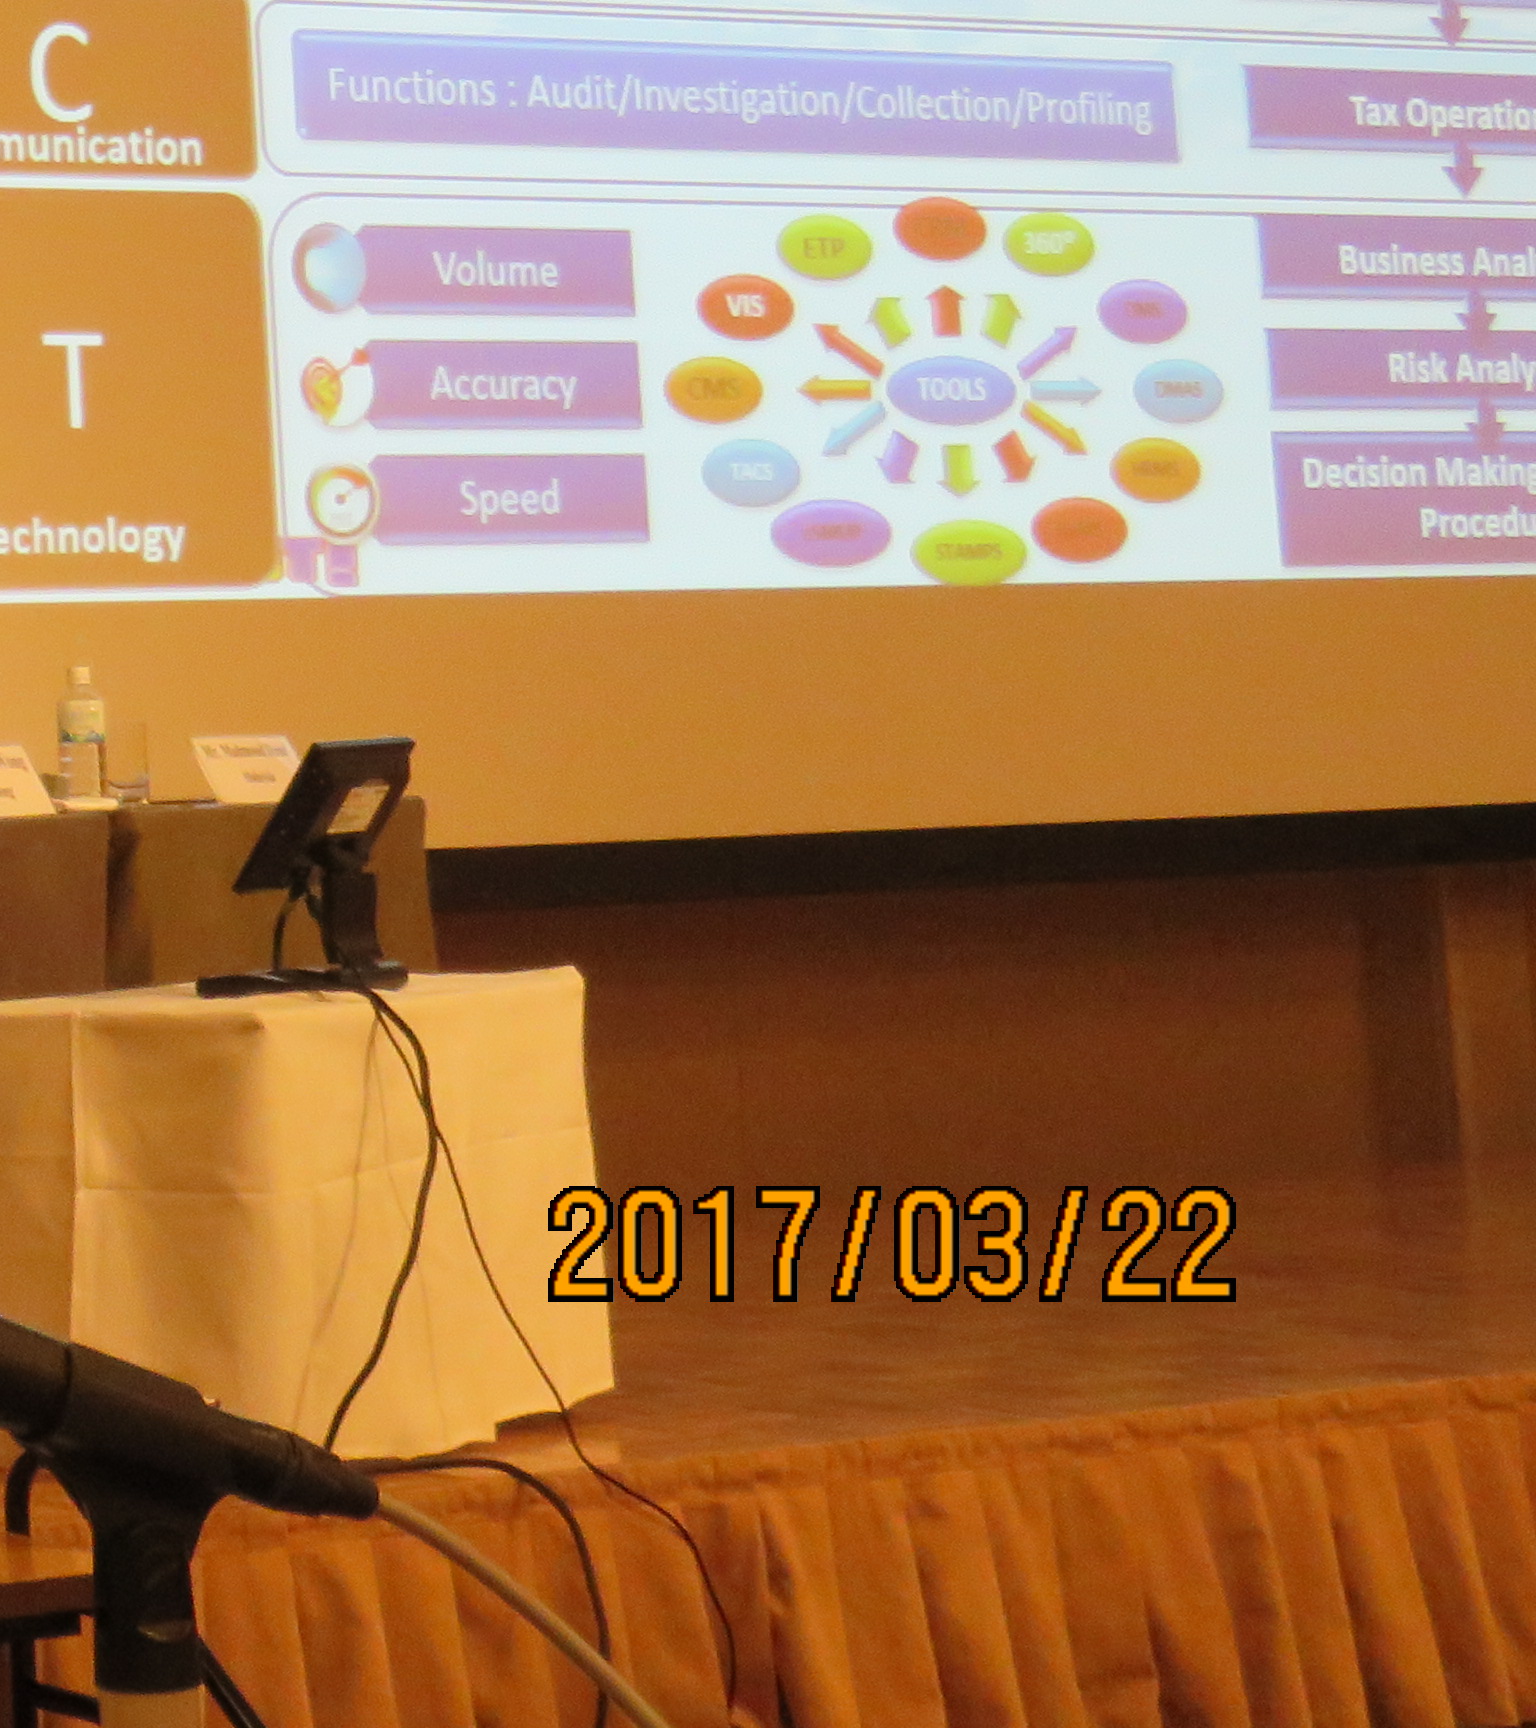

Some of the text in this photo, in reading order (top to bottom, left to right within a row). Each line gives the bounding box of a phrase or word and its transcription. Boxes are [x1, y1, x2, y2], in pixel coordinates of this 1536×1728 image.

[30, 21, 94, 123] C
[327, 68, 497, 109] Functions
[1348, 95, 1536, 138] Tax Operatio
[802, 236, 847, 259] ETP
[1337, 243, 1465, 276] Business
[431, 249, 560, 289] Volume
[724, 294, 766, 318] VIS
[41, 331, 105, 430] T
[430, 365, 579, 411] Accuracy
[1387, 352, 1449, 384] Risk
[916, 376, 988, 403] TOOLS
[1302, 455, 1536, 495] Decision Making
[458, 477, 561, 523] Speed
